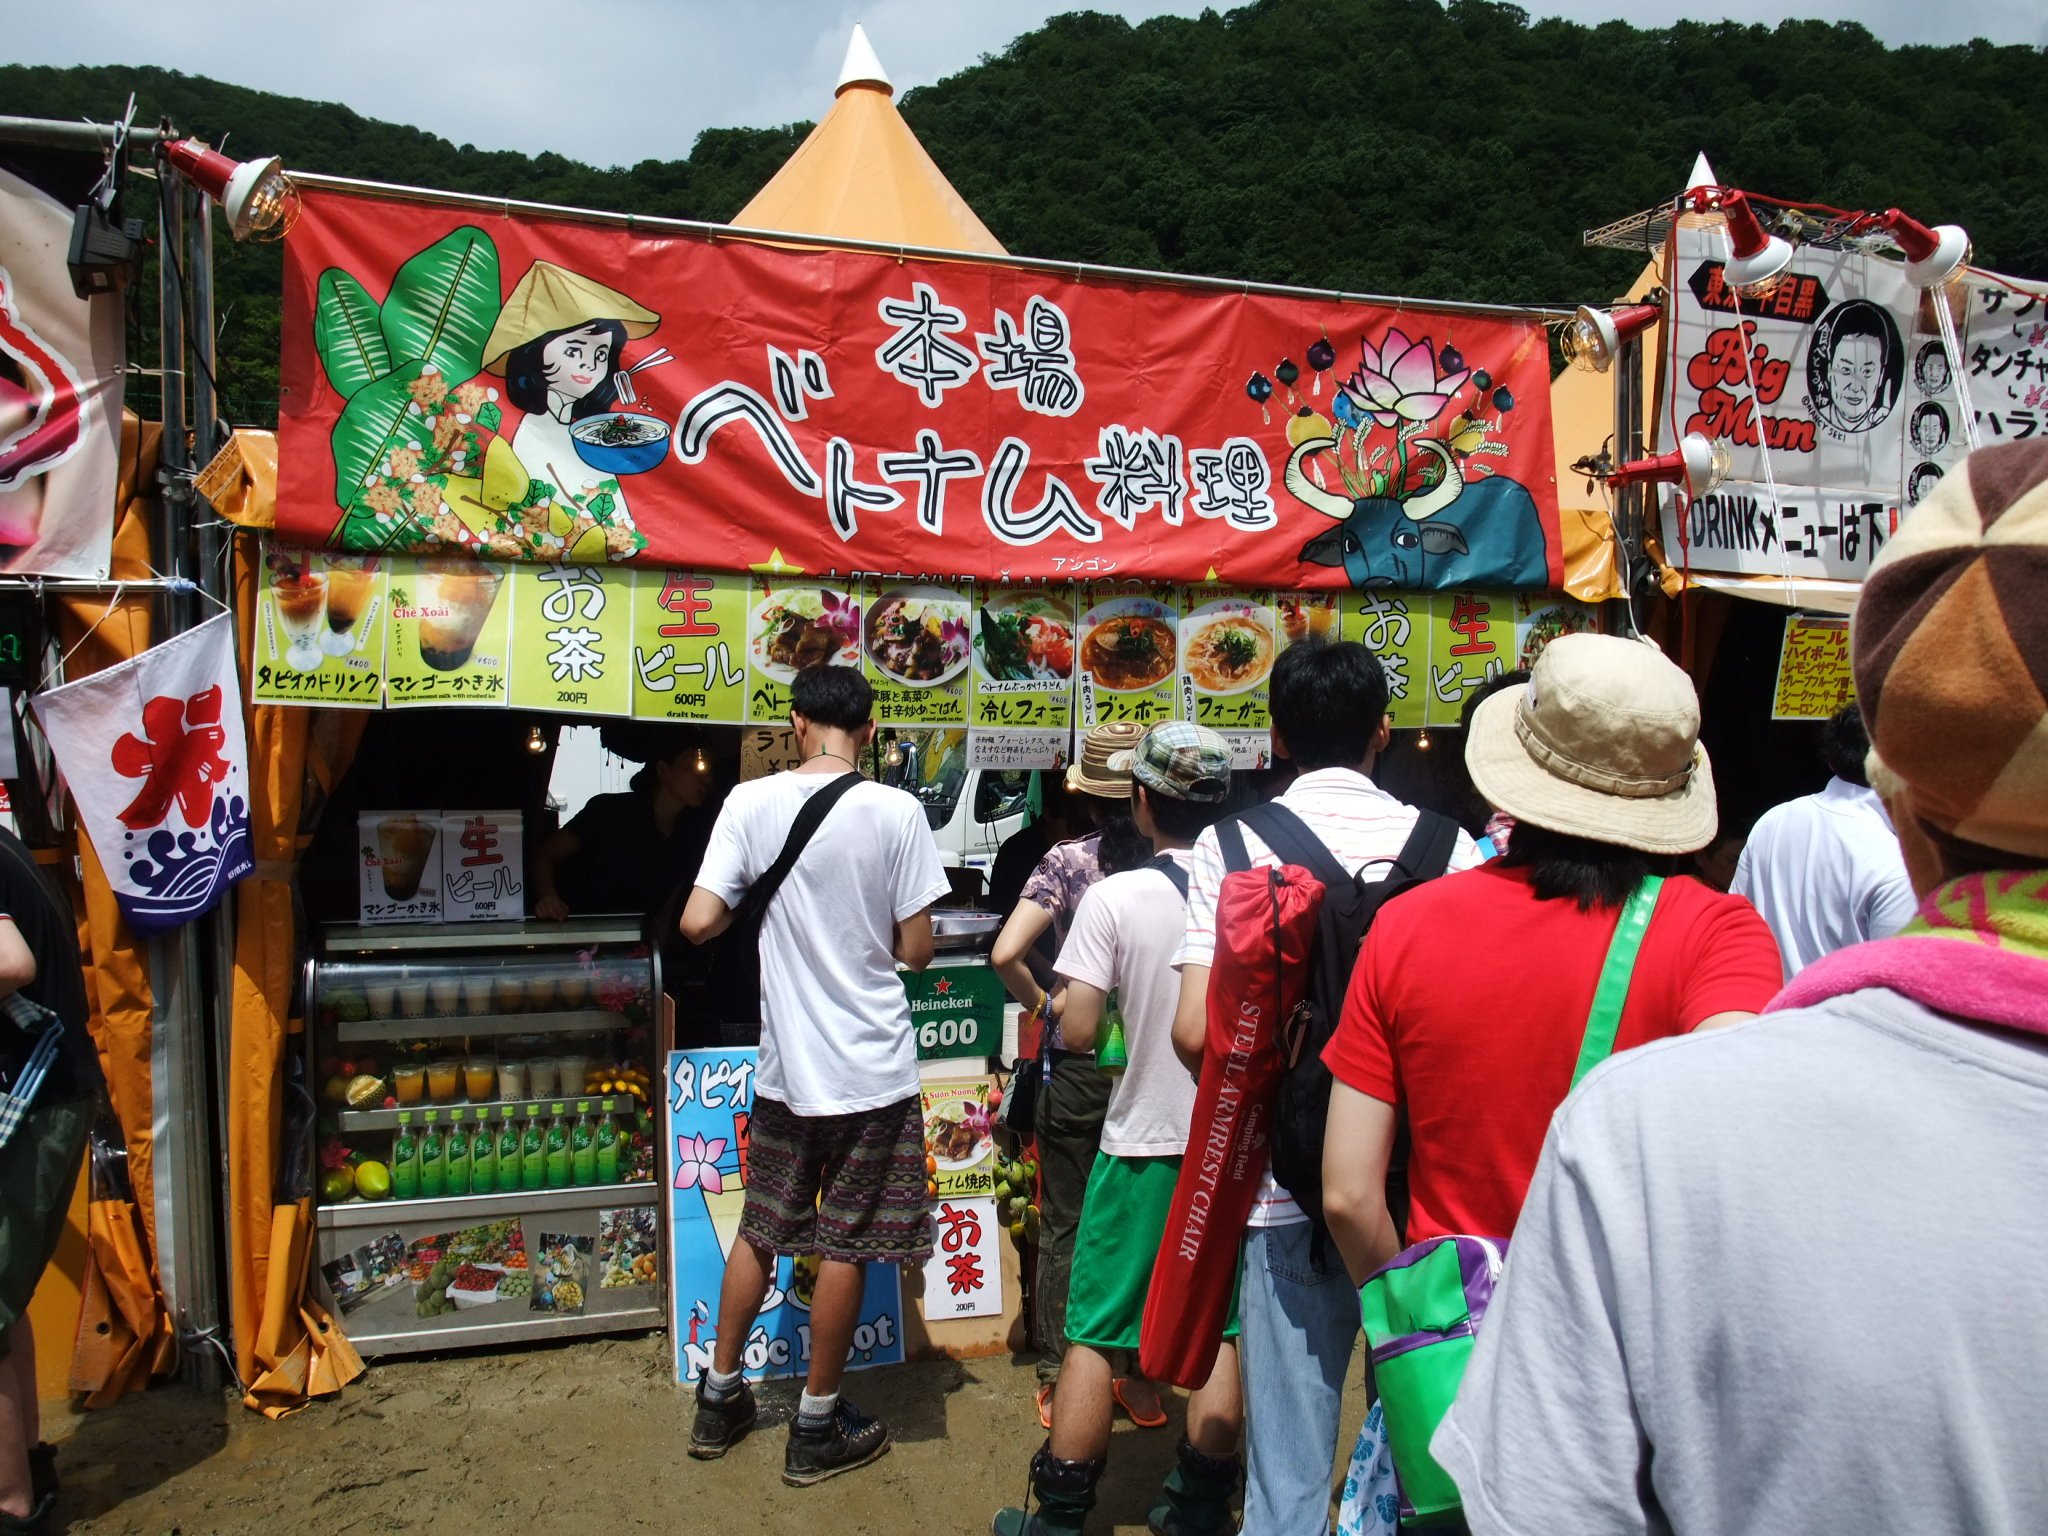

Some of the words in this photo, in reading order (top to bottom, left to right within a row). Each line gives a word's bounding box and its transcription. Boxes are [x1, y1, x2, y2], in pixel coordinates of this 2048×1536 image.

[1703, 265, 1818, 319] 東目黒
[877, 281, 1085, 418] 本場
[1687, 320, 1791, 405] Big
[675, 342, 1278, 546] ベトナム料理
[1974, 410, 2048, 439] ハラ
[1051, 557, 1116, 571] アンゴン
[537, 561, 607, 682] お茶
[658, 567, 720, 637] 生
[1450, 590, 1497, 657] 生
[635, 642, 744, 692] ビール
[1786, 646, 1849, 661] ハイボール
[258, 665, 379, 694] タピオカドリンク
[389, 674, 505, 692] マンゴーかき氷
[557, 692, 588, 705] 200円
[674, 694, 706, 707] 600円
[753, 683, 795, 711] ベト
[1082, 674, 1093, 725] 牛肉うどん
[666, 711, 688, 719] draft
[690, 711, 709, 719] beer
[980, 699, 1067, 722] 冷しフォー
[1096, 695, 1171, 722] ブンボー
[1198, 697, 1267, 720] フォーガー
[111, 684, 231, 830] 氷
[460, 815, 503, 867] 生
[446, 866, 521, 903] ビール
[475, 901, 496, 911] 600円
[363, 901, 441, 915] マンゴーかき氷
[912, 997, 973, 1012] Heineken
[1226, 1001, 1261, 1081] STEEL
[673, 1056, 755, 1113] タピオ
[1198, 1082, 1239, 1190] ARMREST
[1179, 1190, 1211, 1262] CHAIR
[937, 1203, 984, 1296] お茶
[956, 1302, 975, 1311] 200円
[683, 1325, 790, 1381] Nớc
[797, 1314, 895, 1361] ọt
